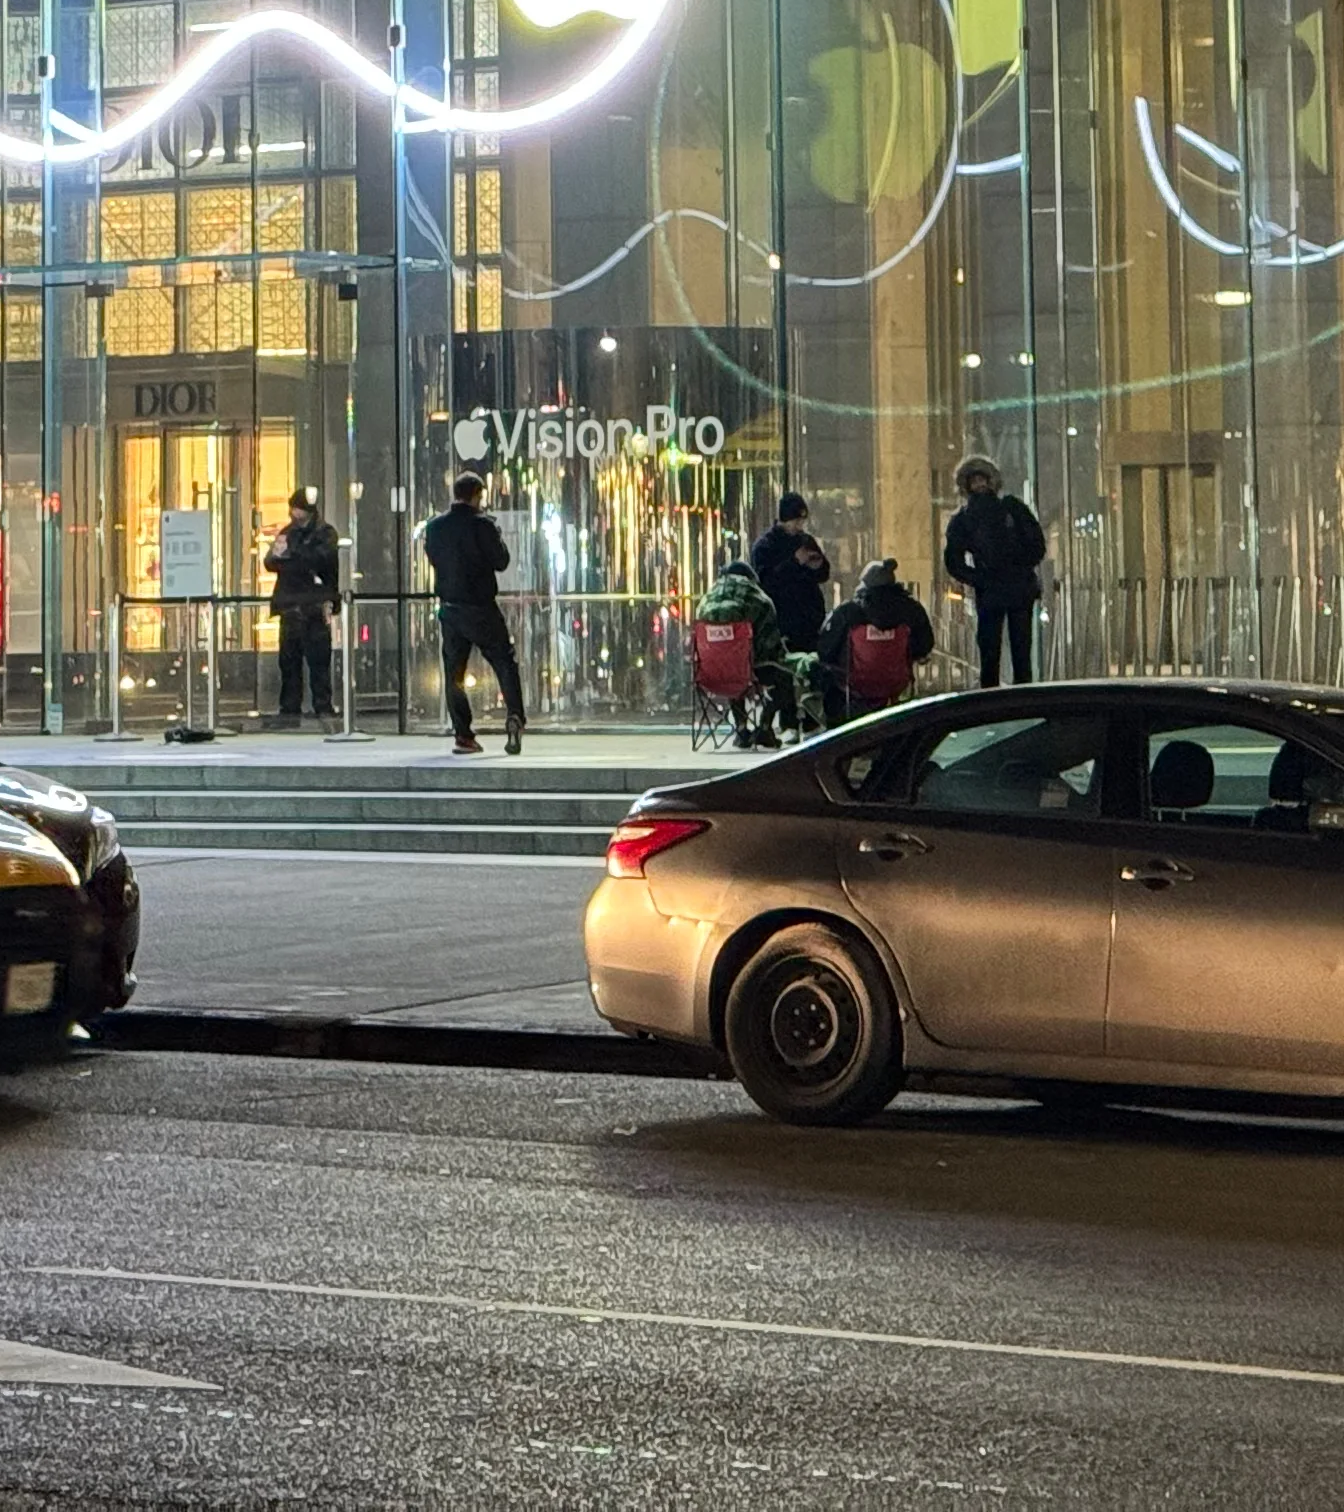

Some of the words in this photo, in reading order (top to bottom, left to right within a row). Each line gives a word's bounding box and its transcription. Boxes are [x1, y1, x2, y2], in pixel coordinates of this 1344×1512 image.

[134, 381, 217, 417] DIOR
[490, 404, 633, 460] Vision
[646, 403, 725, 456] Pro
